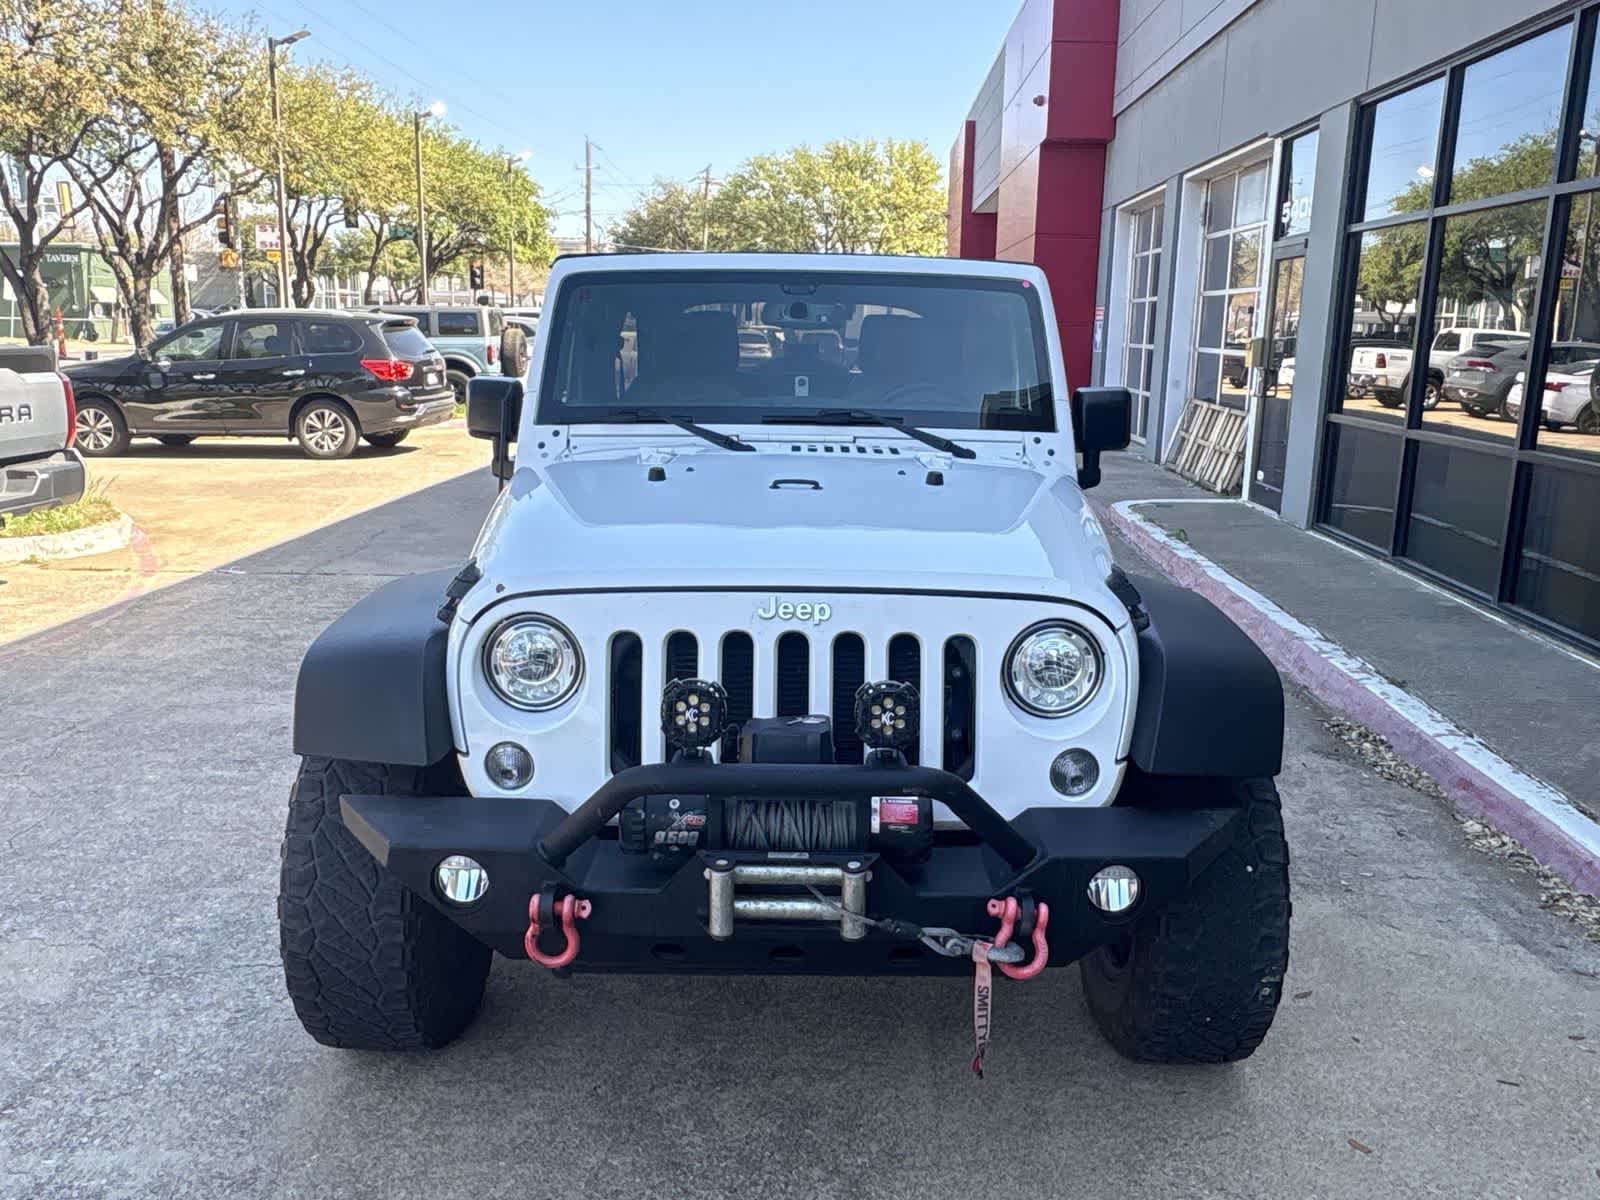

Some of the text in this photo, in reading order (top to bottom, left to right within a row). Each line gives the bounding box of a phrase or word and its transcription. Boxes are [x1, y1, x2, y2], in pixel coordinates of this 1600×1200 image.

[46, 254, 79, 263] TAVERN
[757, 595, 832, 625] Jeep
[685, 707, 699, 722] KC
[881, 711, 895, 726] KC
